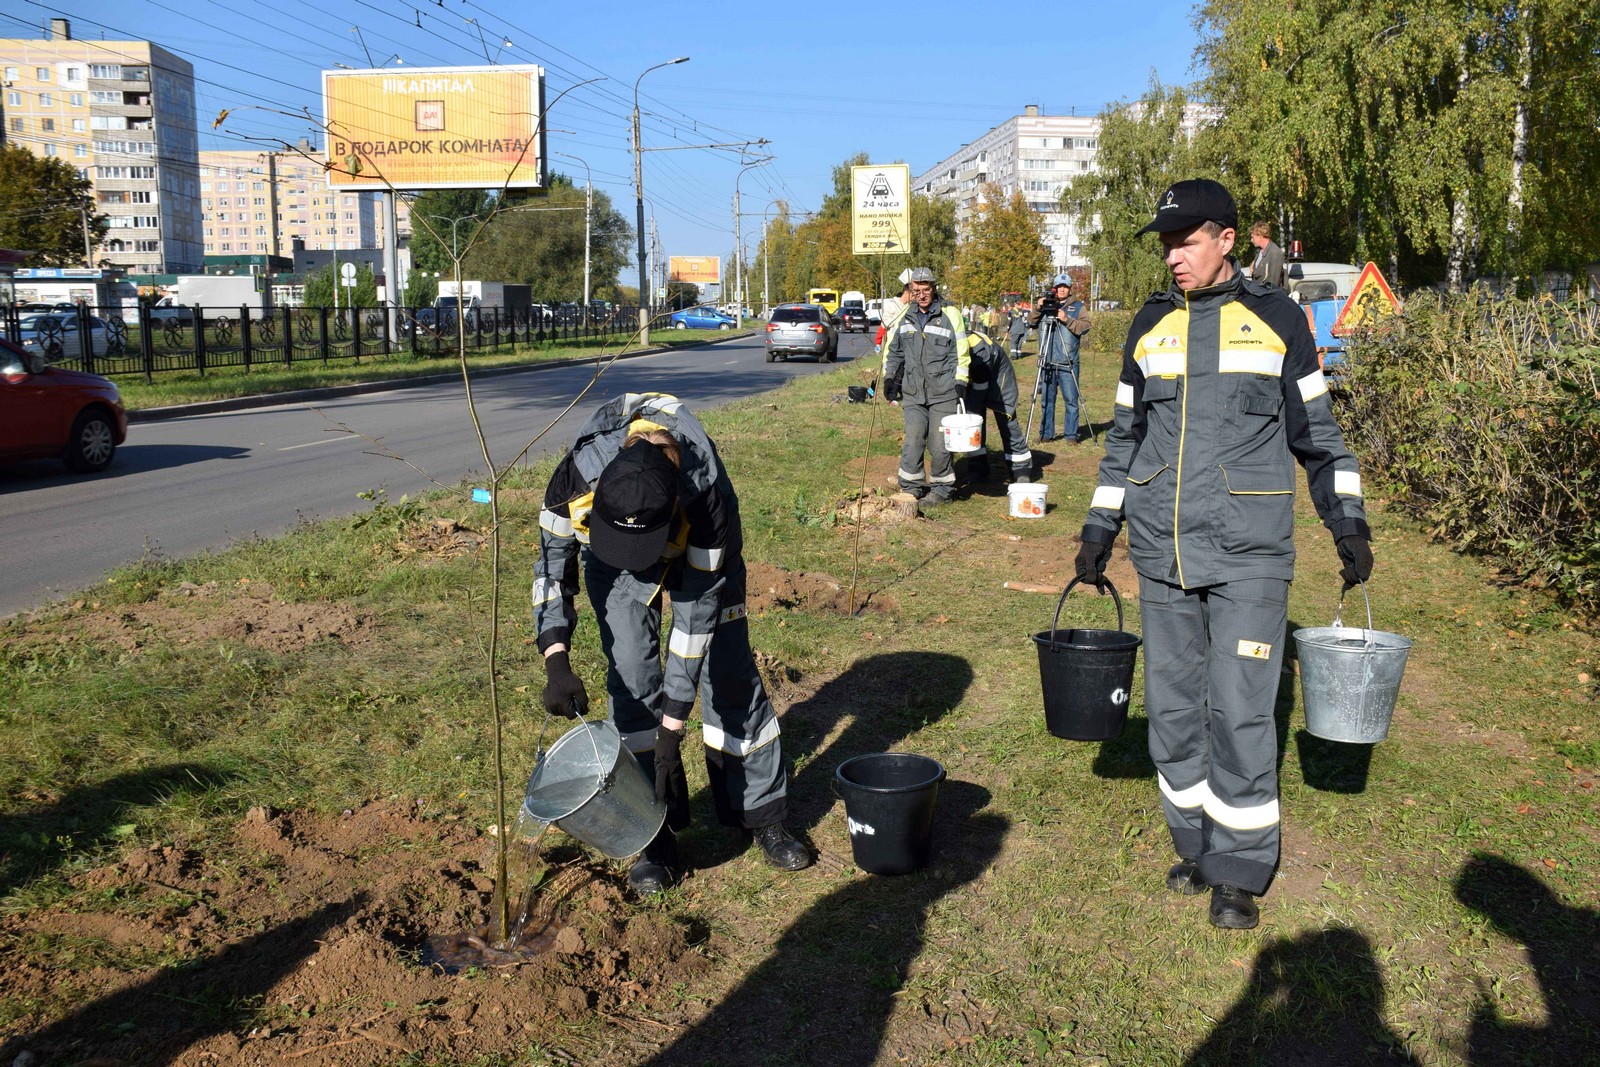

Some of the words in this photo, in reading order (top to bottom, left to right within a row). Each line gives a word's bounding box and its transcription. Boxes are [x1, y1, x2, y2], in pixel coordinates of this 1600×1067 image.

[335, 142, 346, 156] В
[352, 140, 433, 158] ПОДАРОК
[439, 138, 529, 154] КОМНАТА!
